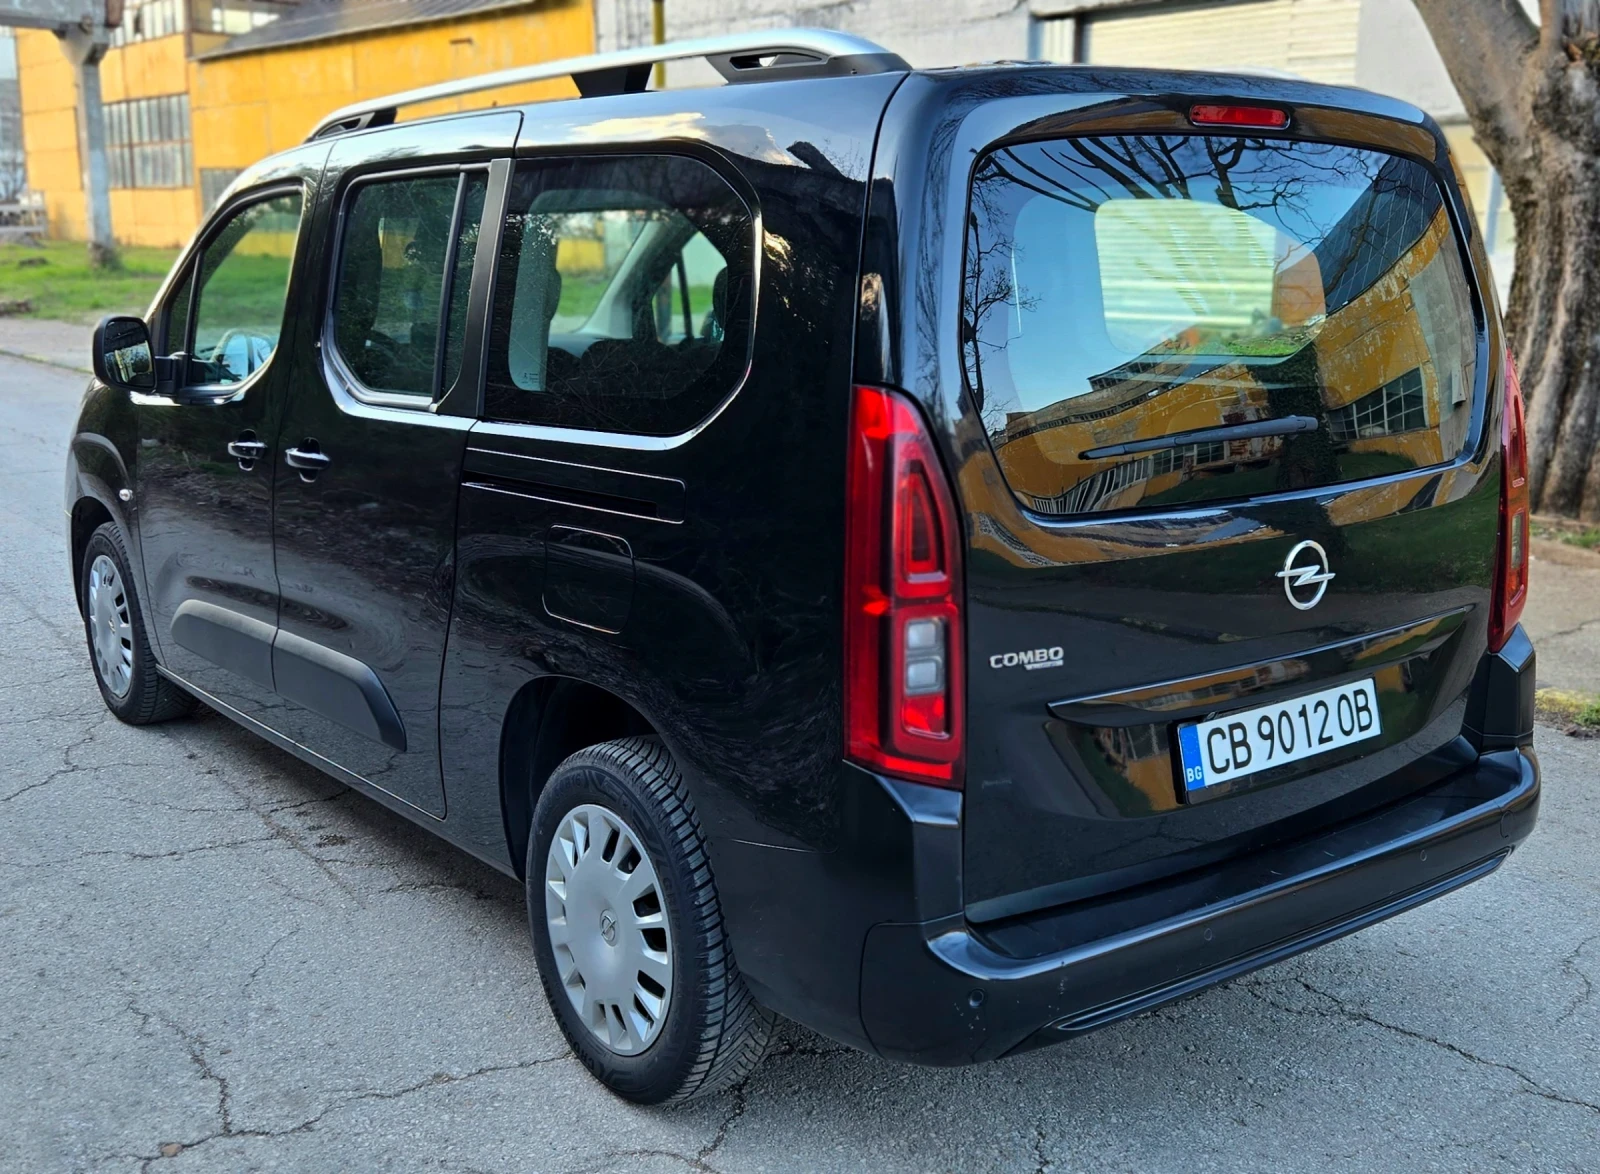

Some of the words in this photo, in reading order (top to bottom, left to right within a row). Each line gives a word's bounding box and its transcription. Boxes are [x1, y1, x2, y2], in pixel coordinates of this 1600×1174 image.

[989, 646, 1064, 669] COMBO
[1207, 721, 1252, 774] CB
[1257, 700, 1333, 761] 9012
[1186, 765, 1203, 783] BG
[541, 973, 595, 1071] CROSSWIND
